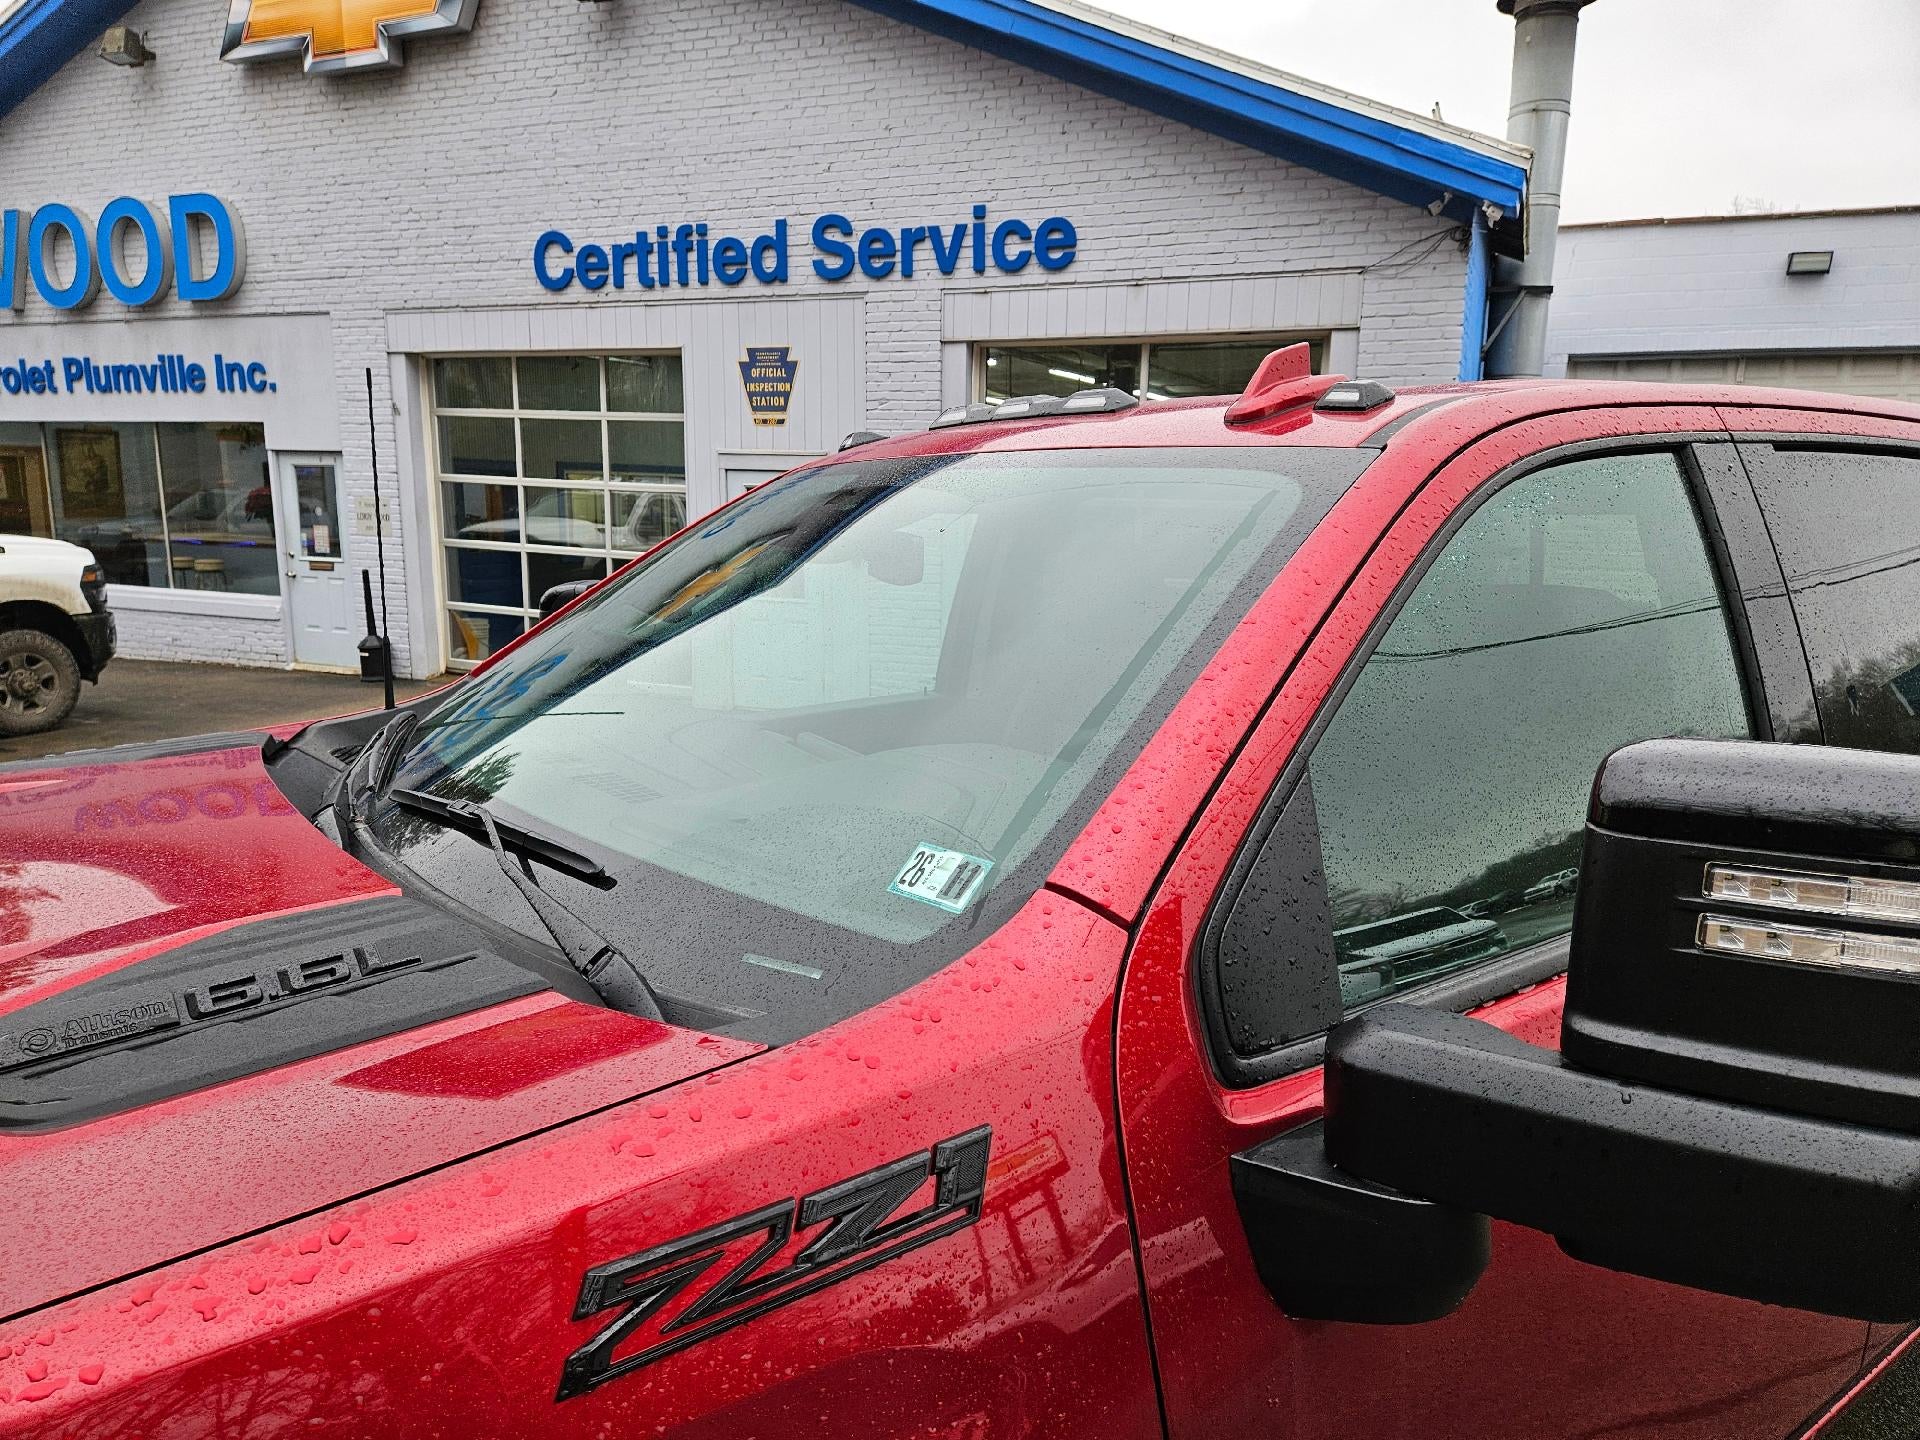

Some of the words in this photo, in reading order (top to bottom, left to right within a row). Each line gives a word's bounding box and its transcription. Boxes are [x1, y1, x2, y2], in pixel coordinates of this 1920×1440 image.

[534, 218, 788, 291] Certified
[812, 204, 1078, 281] Service
[62, 354, 207, 394] Plumville
[214, 354, 277, 392] Inc.
[747, 382, 791, 392] INSPECTION
[751, 368, 786, 378] OFFICIAL
[752, 396, 785, 407] STATION
[898, 850, 936, 888] 26
[184, 943, 424, 1020] 6.6L
[555, 1122, 993, 1403] Z71
